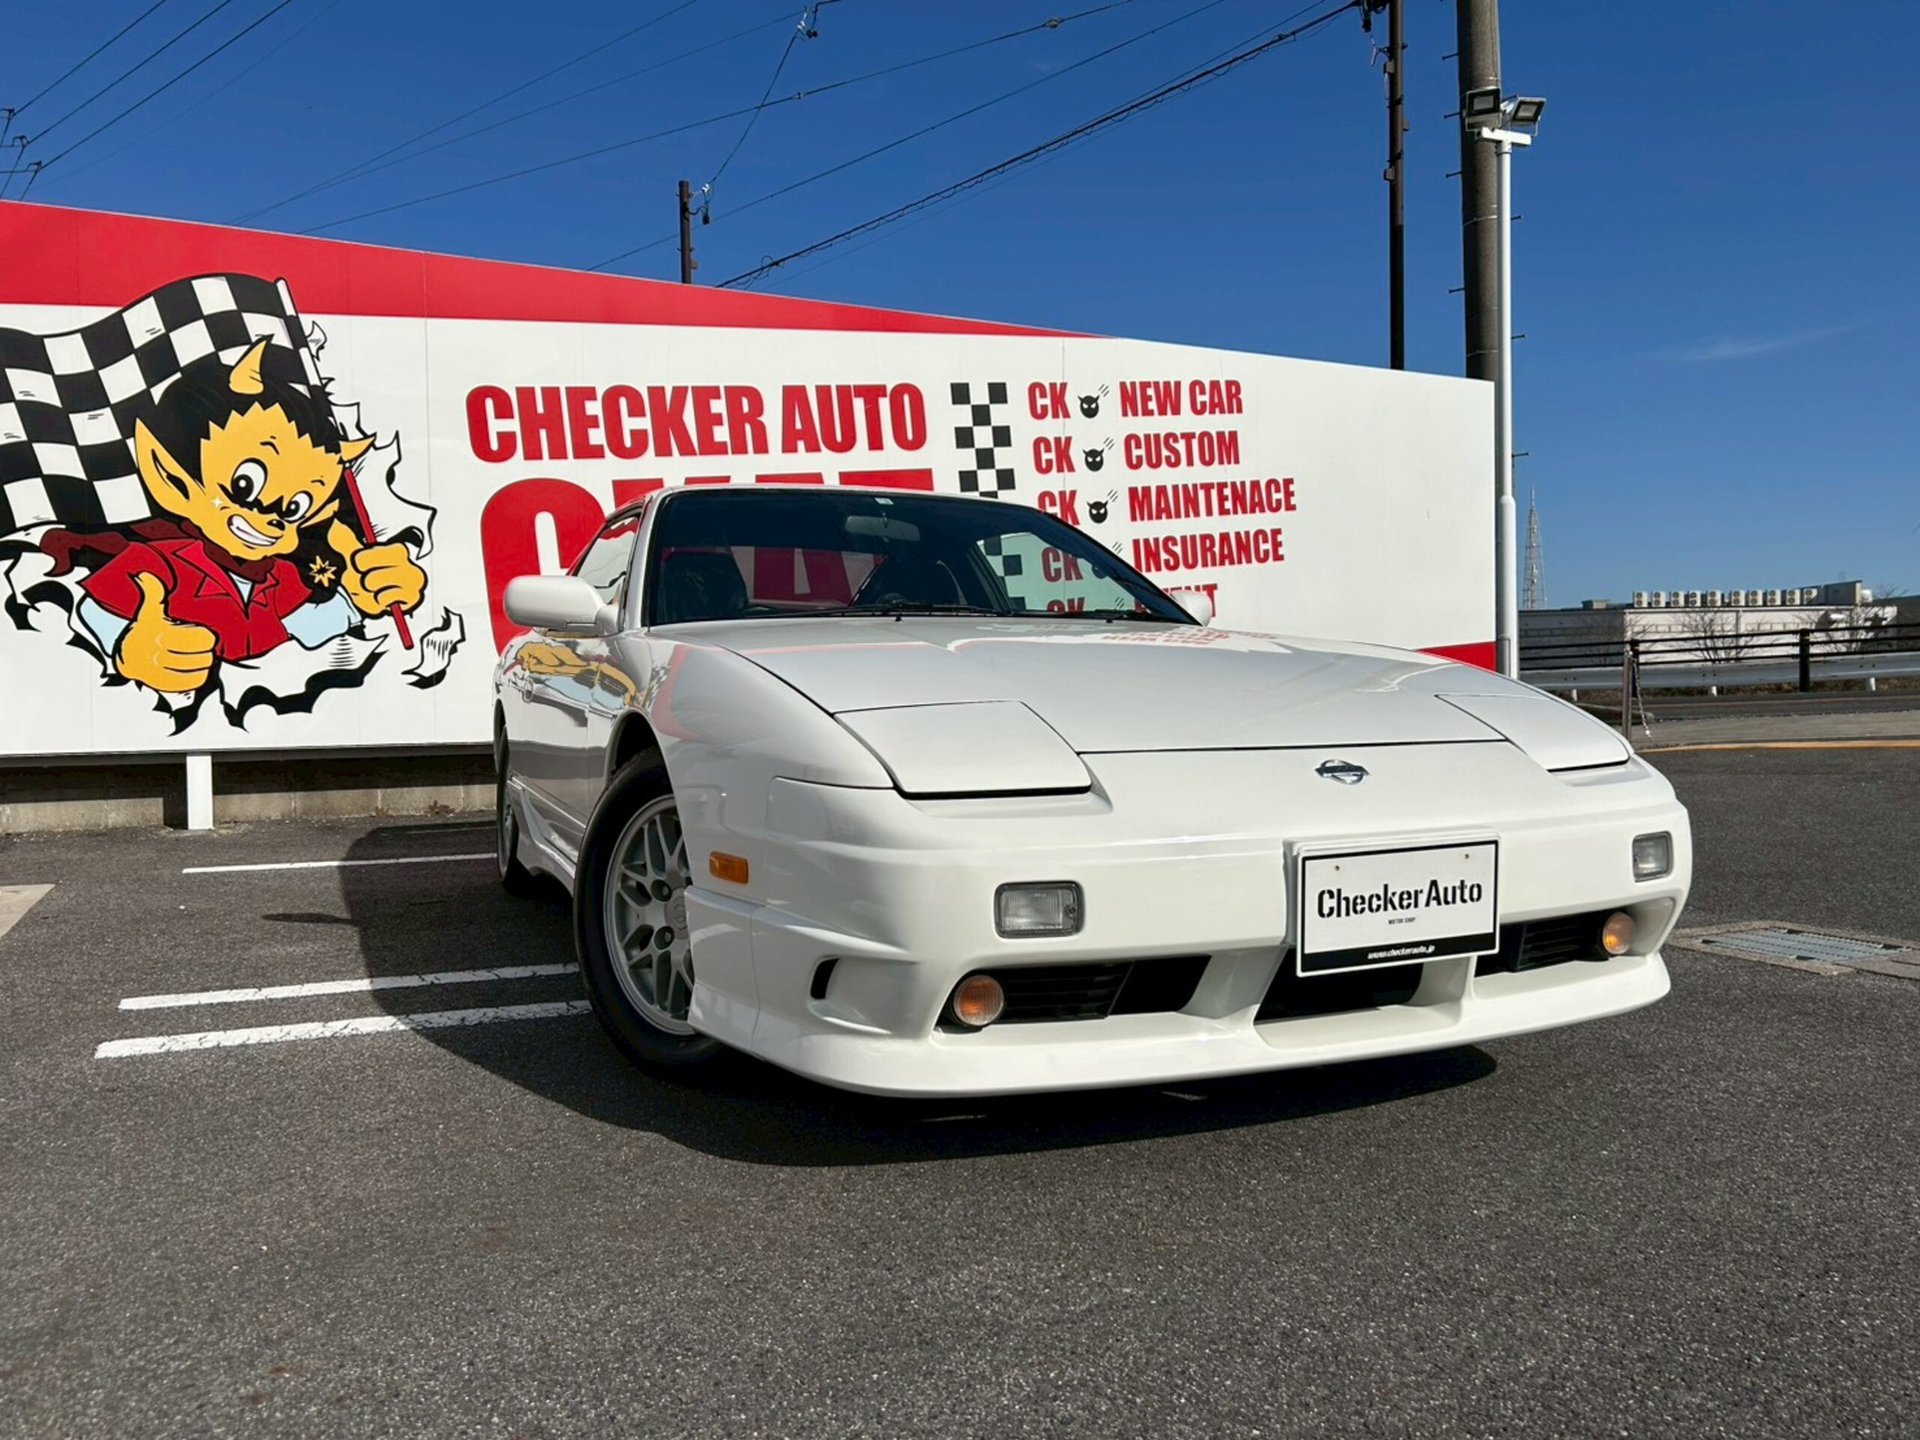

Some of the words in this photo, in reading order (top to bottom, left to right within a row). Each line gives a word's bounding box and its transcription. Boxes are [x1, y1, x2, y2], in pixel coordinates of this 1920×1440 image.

[466, 384, 769, 463] CHECKER
[781, 383, 927, 454] AUTO
[1027, 382, 1071, 421] CK
[1119, 381, 1181, 417] NEW
[1188, 380, 1243, 416] CAR
[1032, 436, 1075, 474] CK
[1123, 431, 1240, 470] CUSTOM
[1037, 490, 1080, 526] CK
[1128, 478, 1296, 522] MAINTENACE
[1041, 547, 1083, 582] CK
[1132, 528, 1285, 573] INSURANCE
